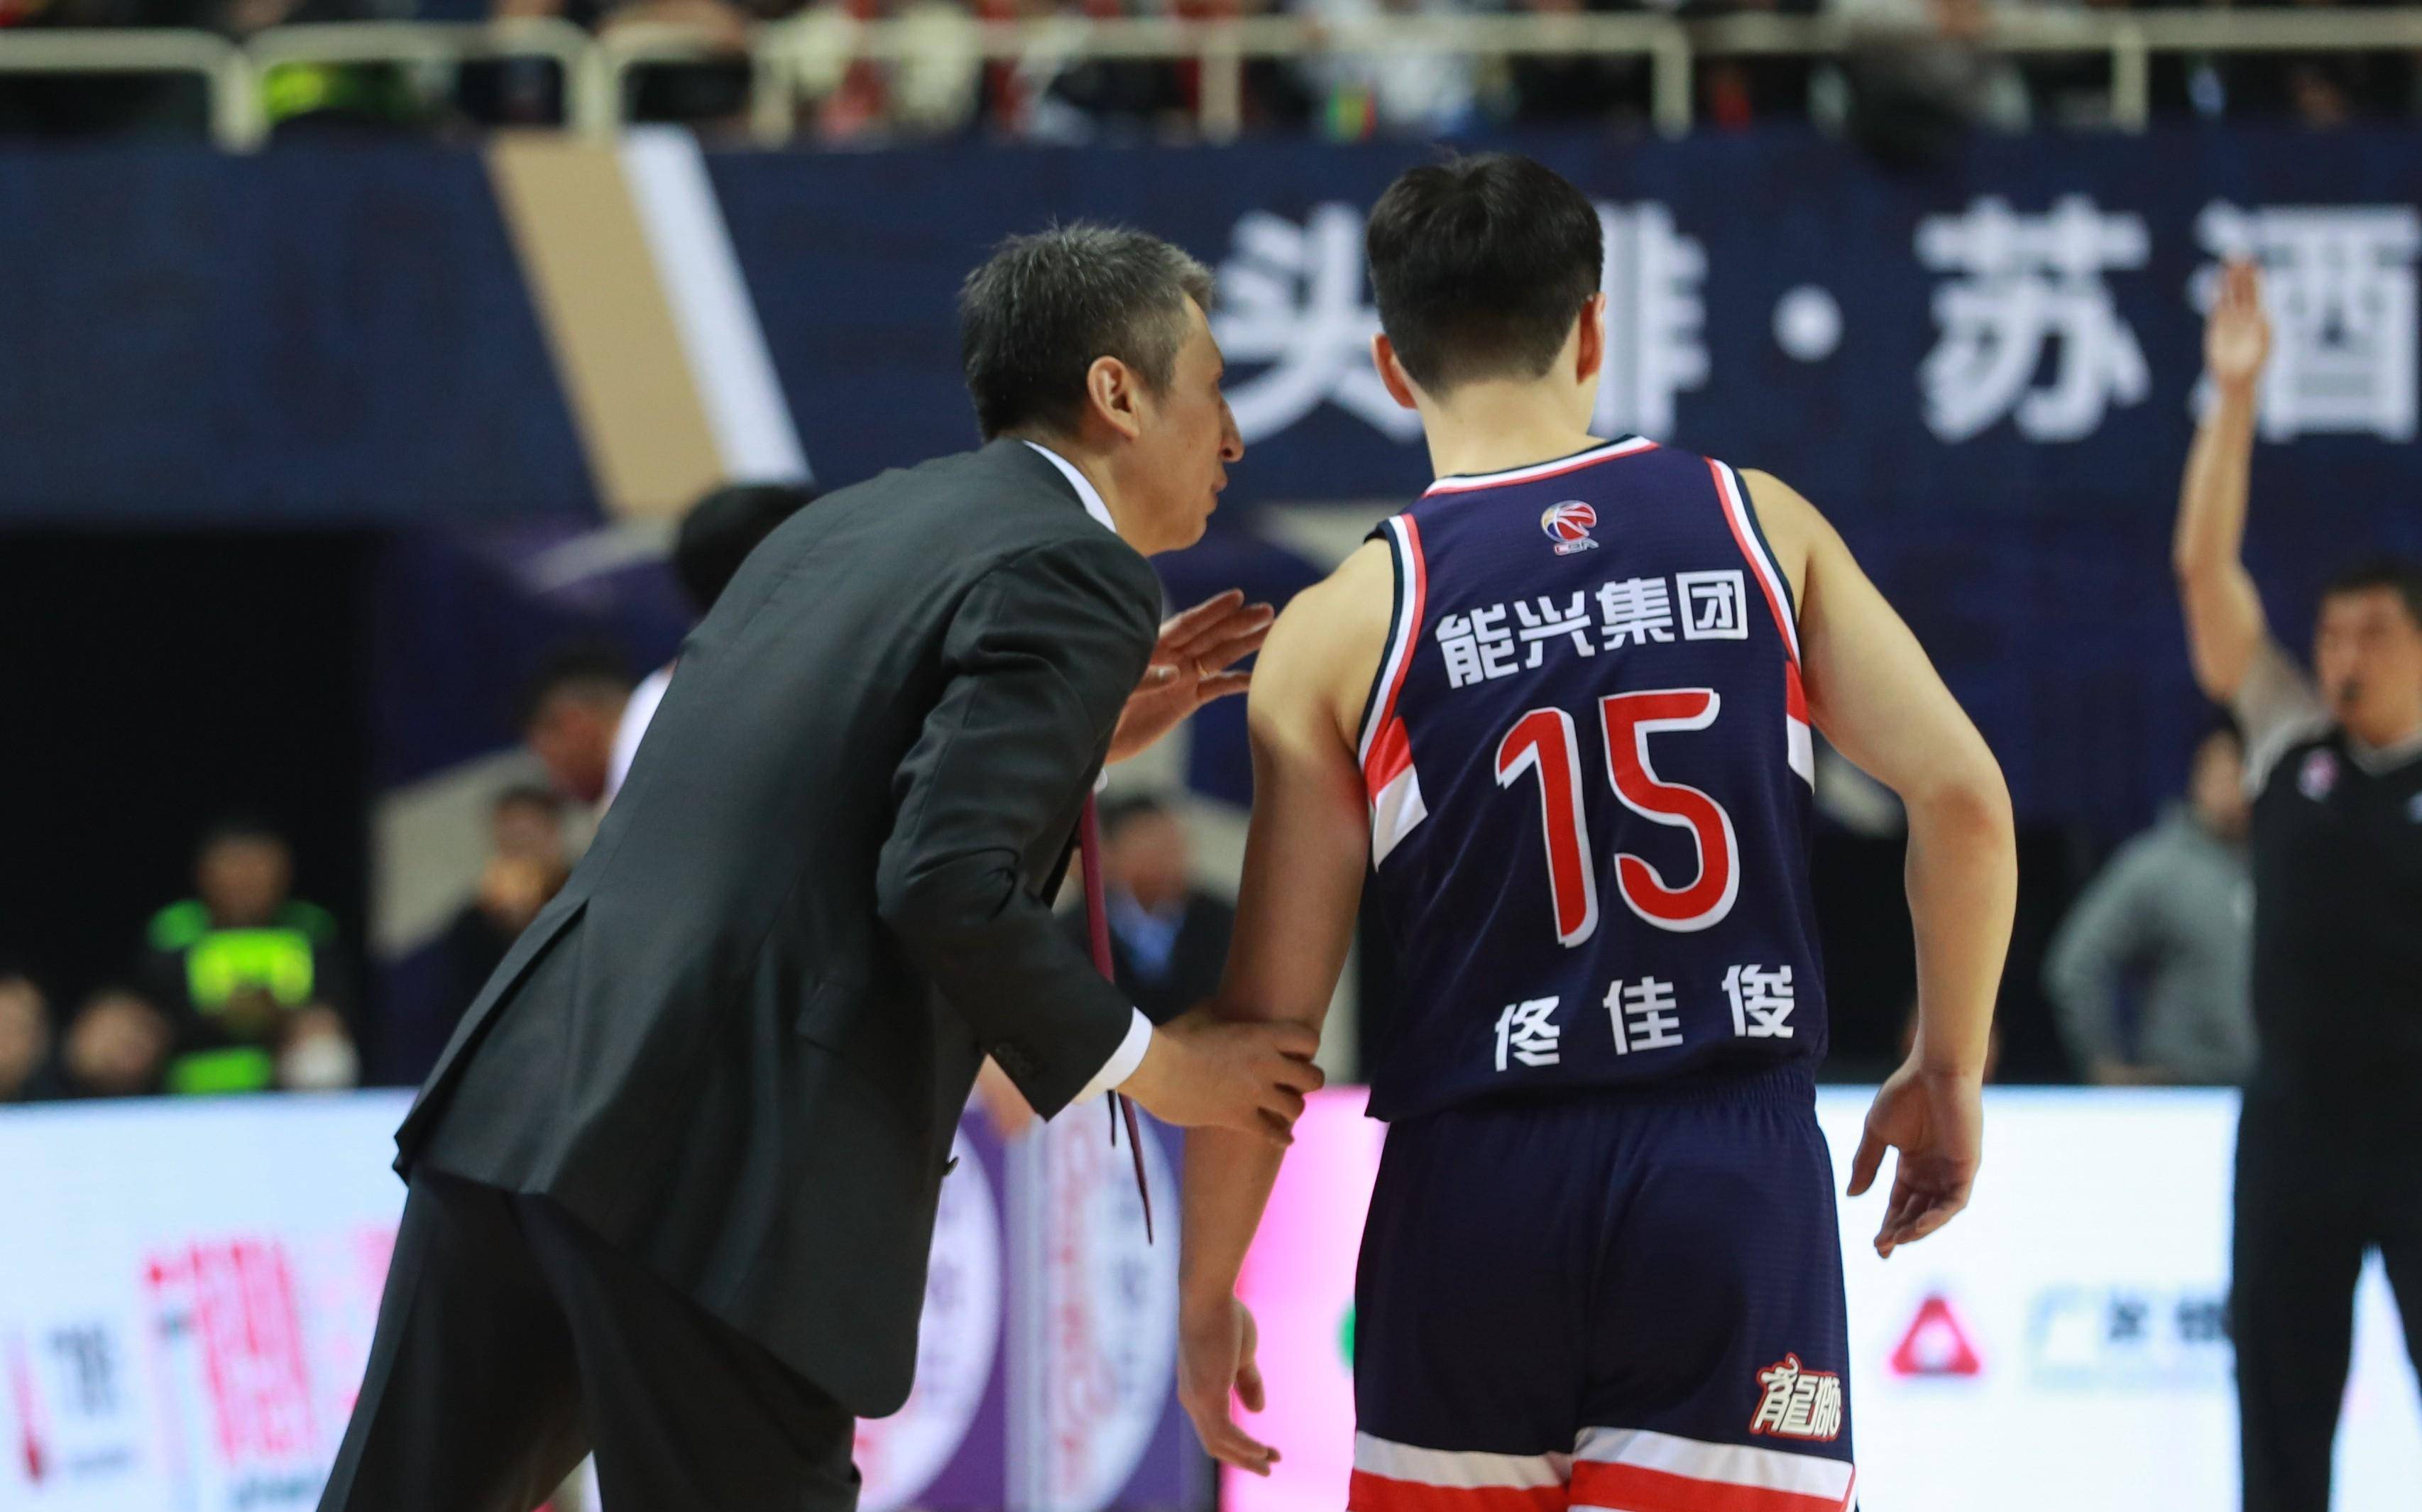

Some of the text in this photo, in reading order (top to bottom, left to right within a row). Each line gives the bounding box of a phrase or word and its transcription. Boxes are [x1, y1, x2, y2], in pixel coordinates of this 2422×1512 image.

[1435, 570, 1748, 689] 能兴集团
[1495, 687, 1740, 948] 15
[1494, 964, 1795, 1073] 佟佳俊
